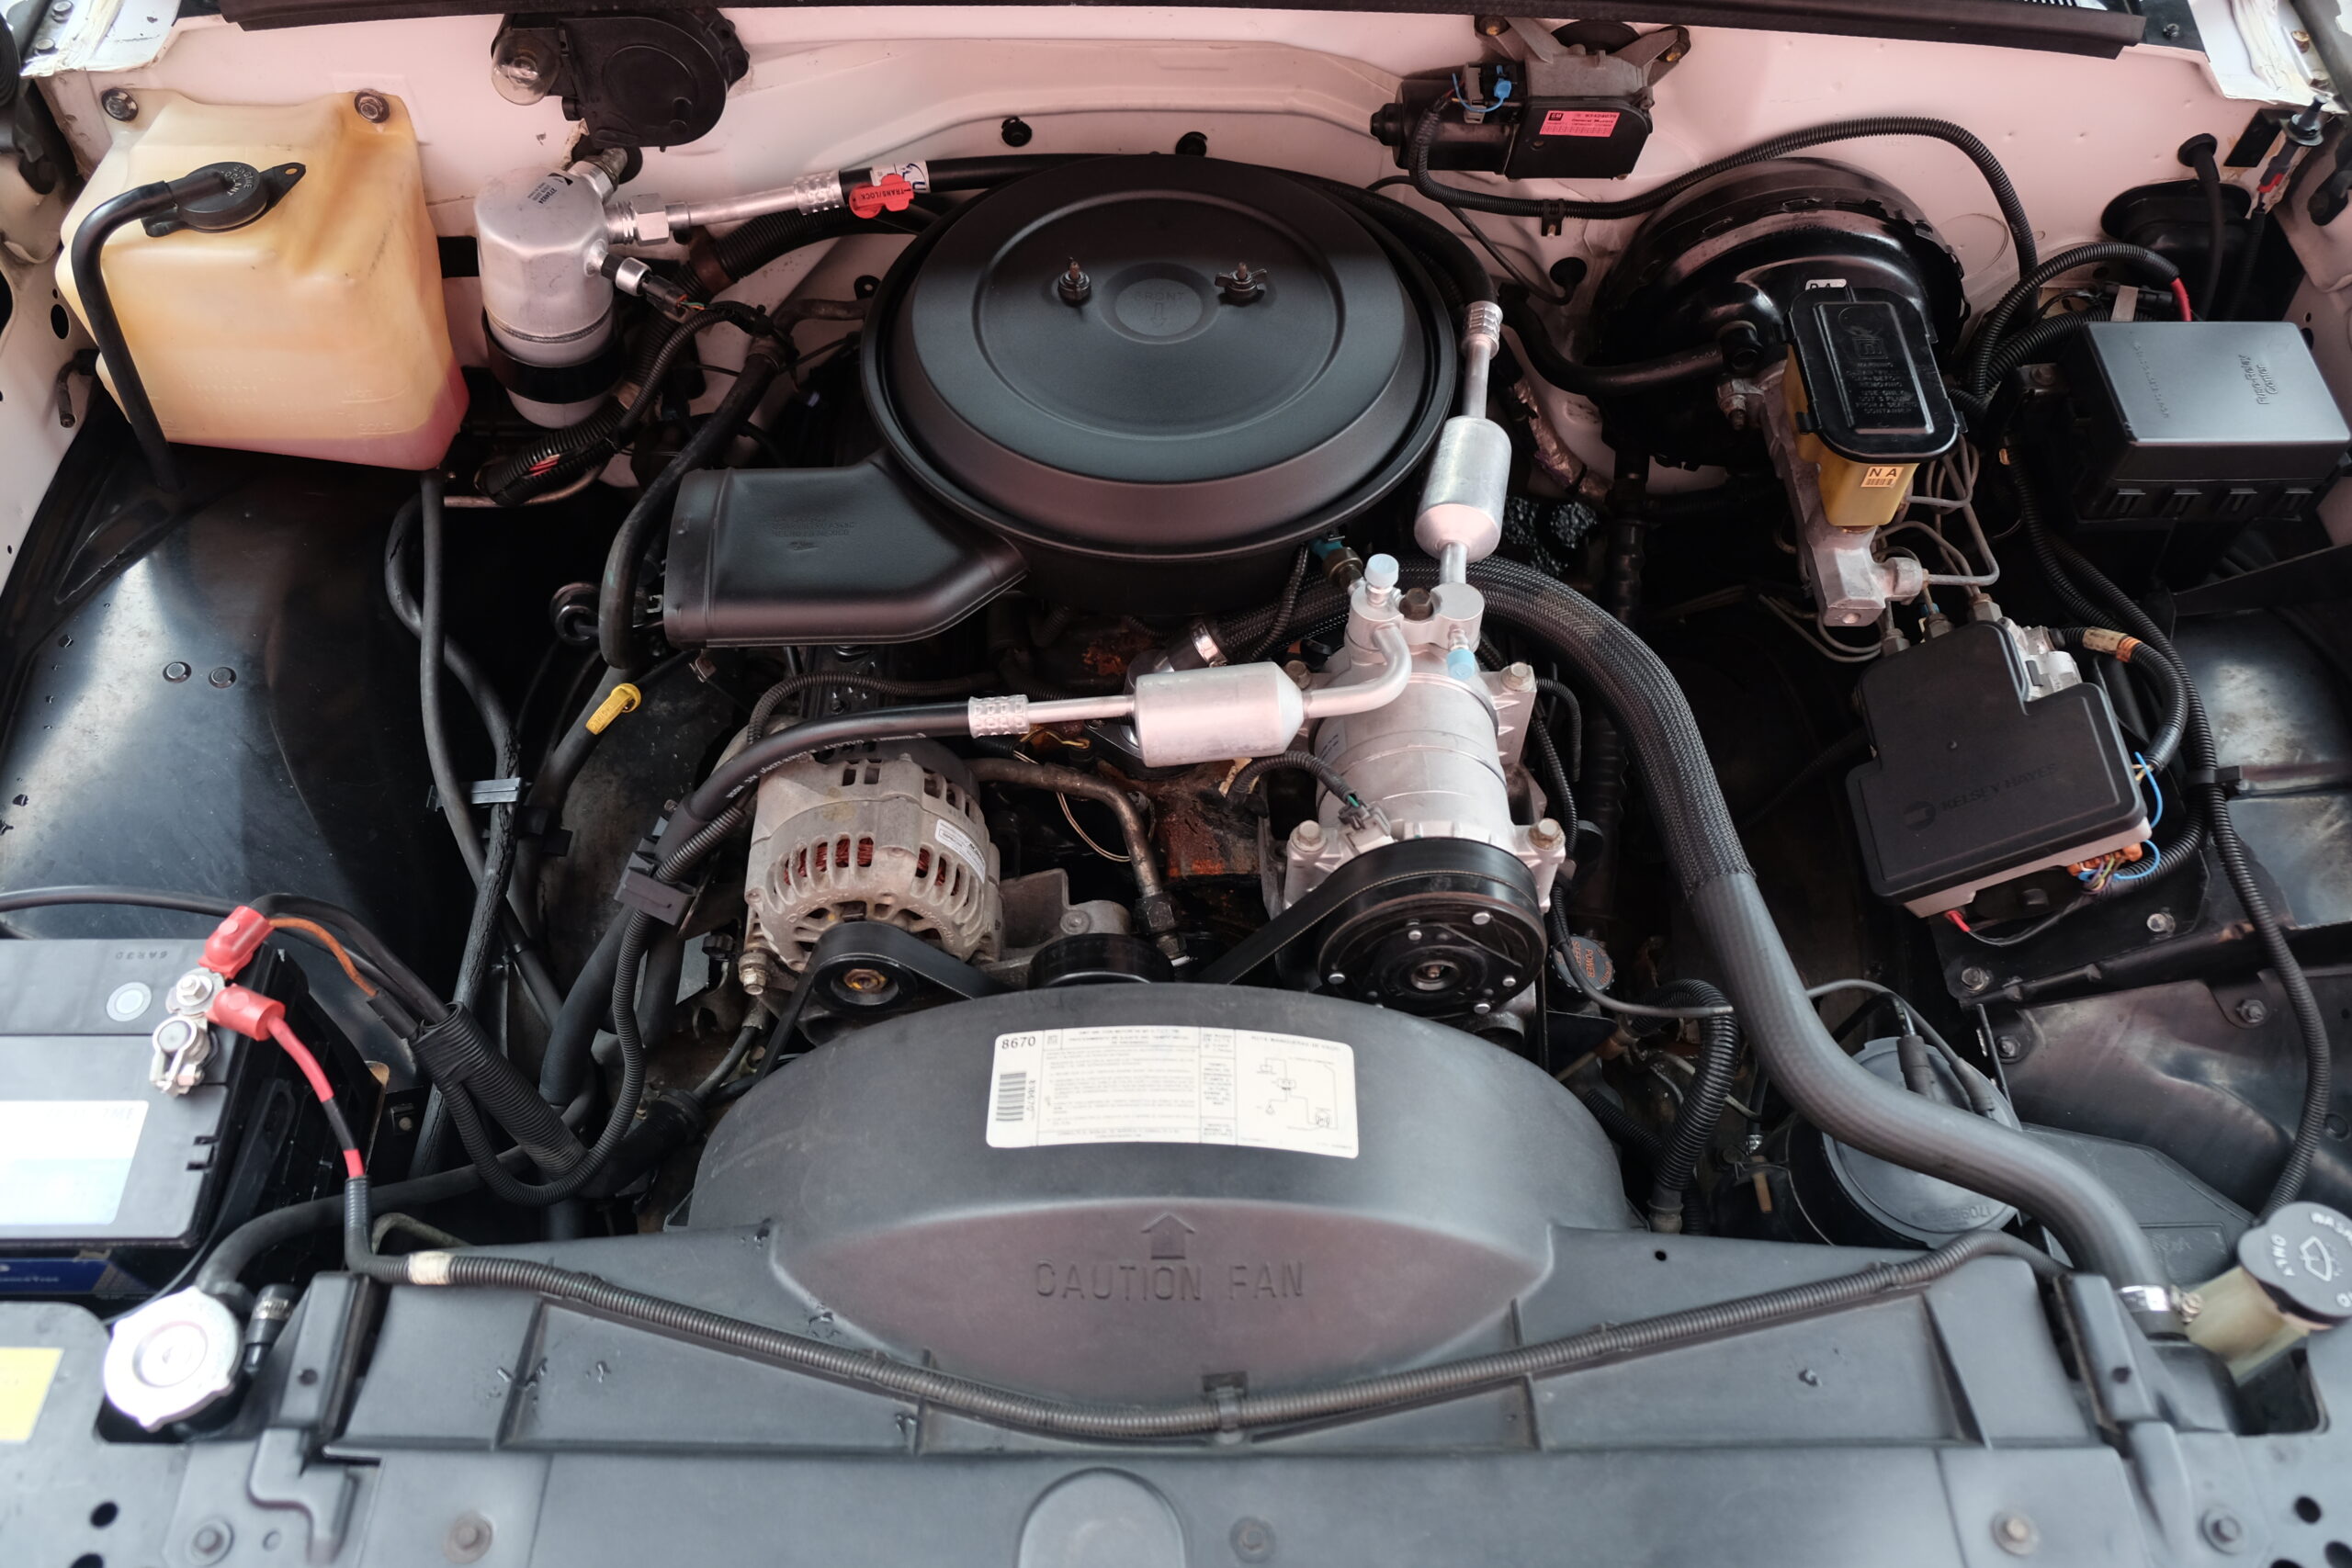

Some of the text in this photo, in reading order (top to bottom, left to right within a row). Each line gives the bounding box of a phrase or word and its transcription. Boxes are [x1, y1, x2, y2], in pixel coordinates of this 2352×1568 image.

[1868, 468, 1897, 477] N A
[1585, 948, 1596, 978] POWER
[1001, 1035, 1036, 1050] 8670
[1035, 1261, 1304, 1301] CAUTION FAN
